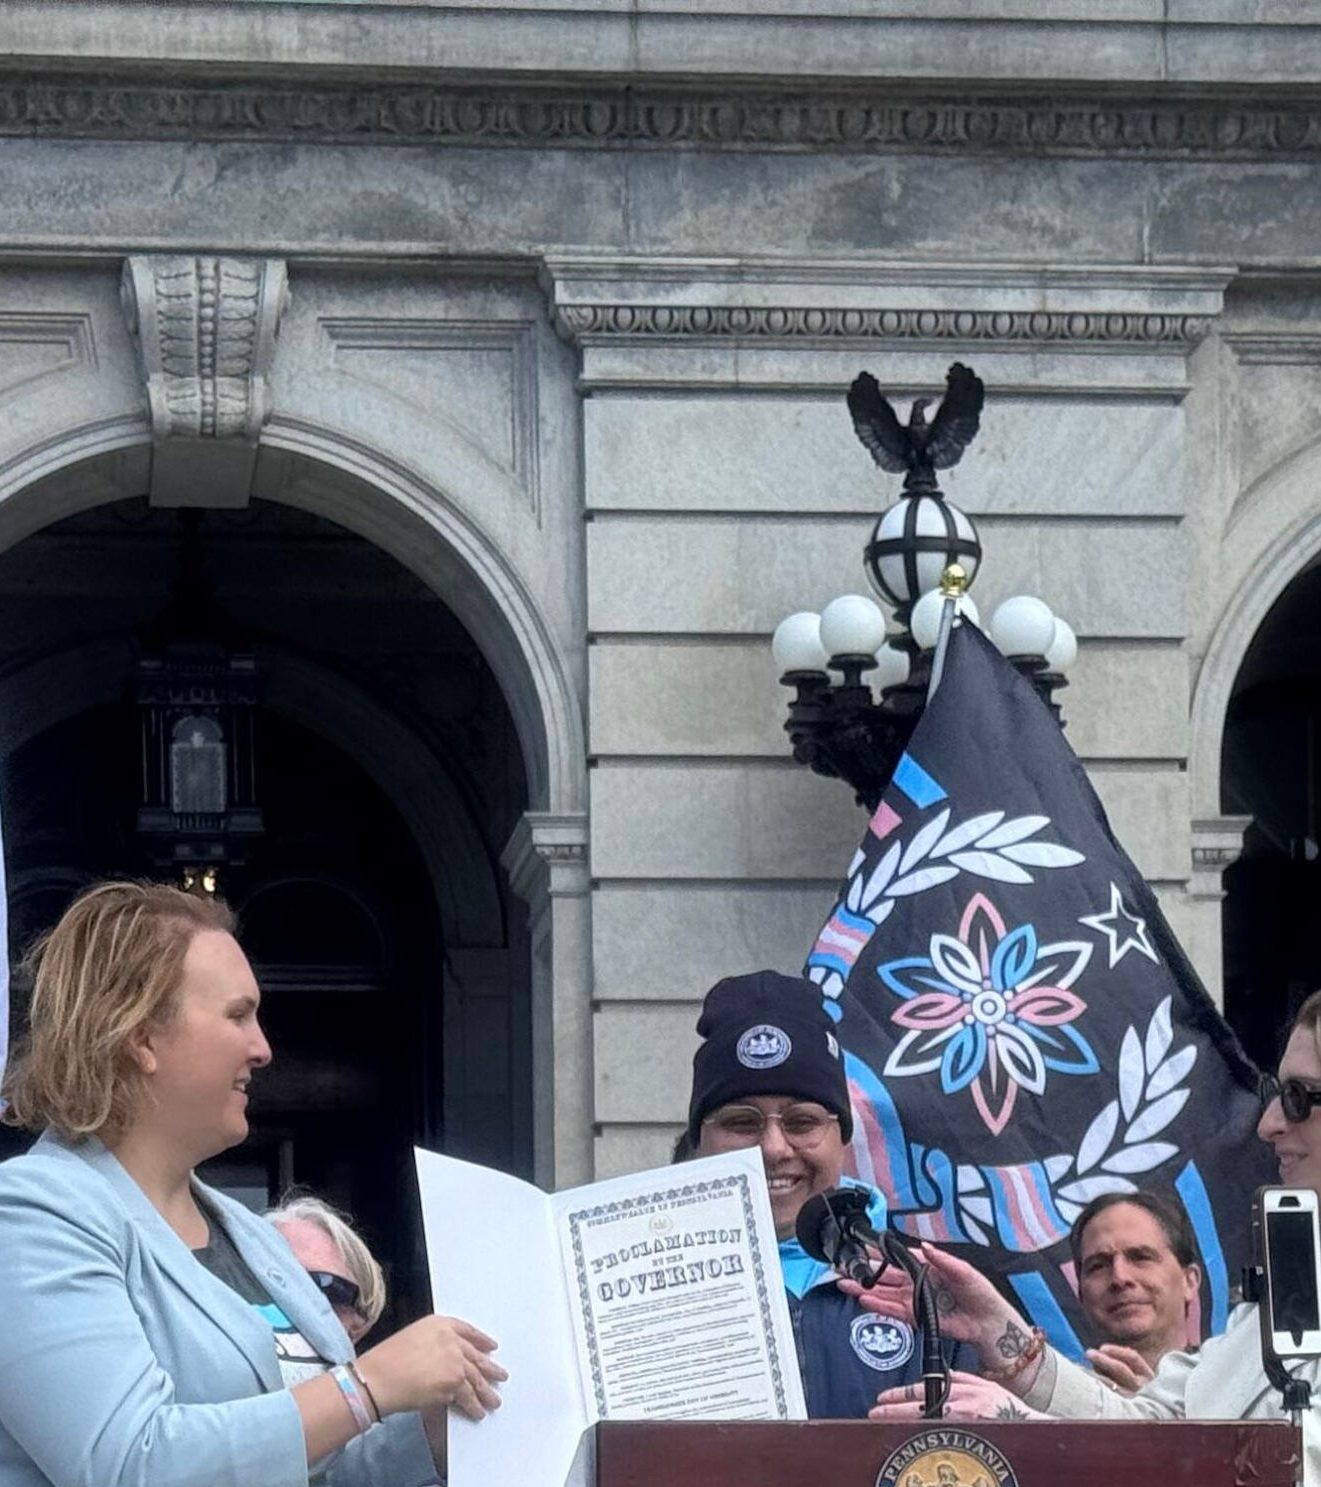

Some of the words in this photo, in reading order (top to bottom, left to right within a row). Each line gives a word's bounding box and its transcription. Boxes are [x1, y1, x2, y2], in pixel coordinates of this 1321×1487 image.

[590, 1228, 742, 1274] PROCLAMATION
[597, 1254, 744, 1301] GOVERNOR
[885, 1432, 1010, 1482] PENNSYLVANIA
